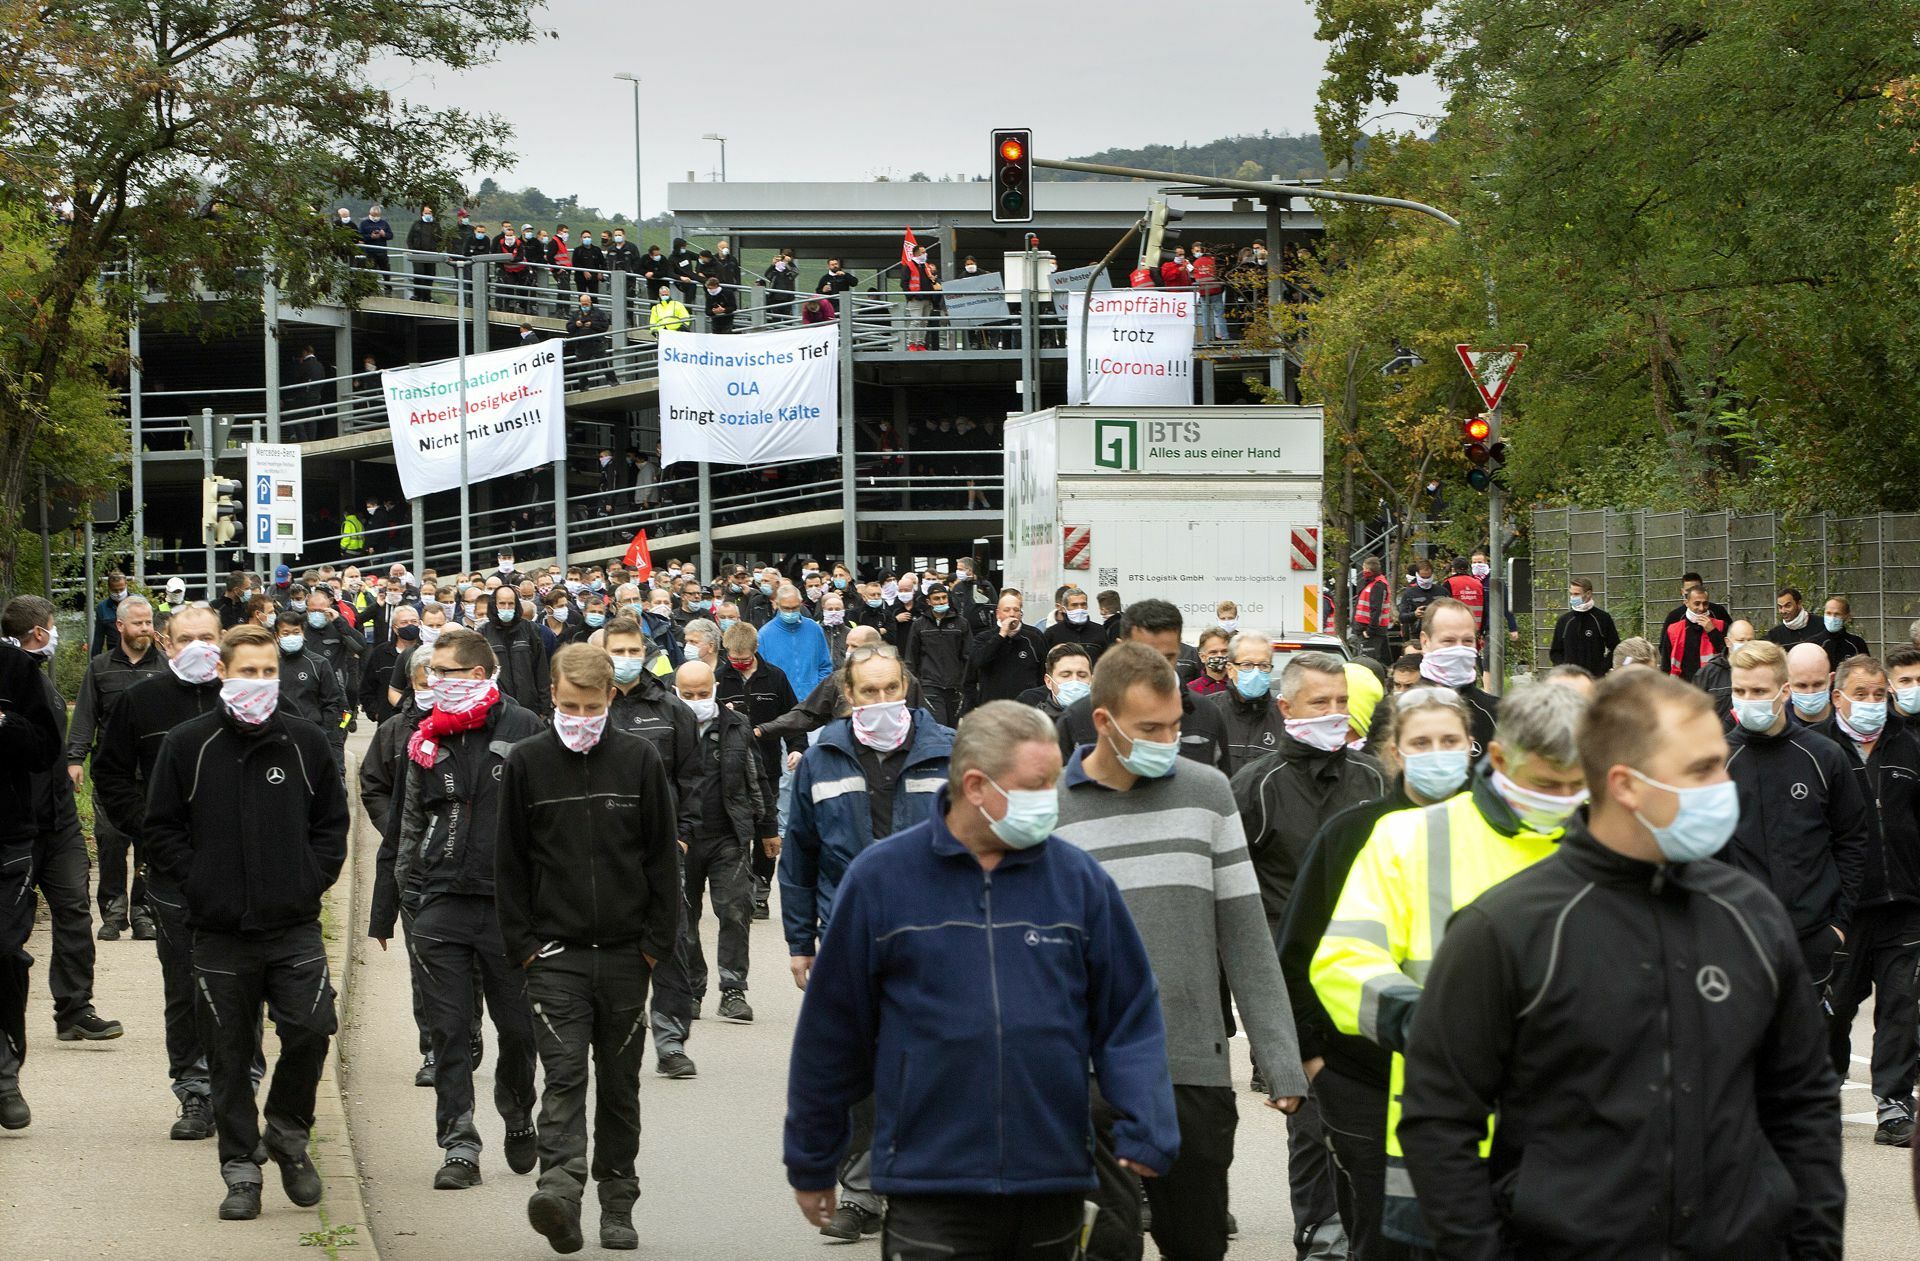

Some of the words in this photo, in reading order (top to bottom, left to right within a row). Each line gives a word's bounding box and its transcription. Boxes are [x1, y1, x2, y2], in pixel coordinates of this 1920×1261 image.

[1112, 327, 1155, 344] trotz
[663, 347, 793, 367] Skandinavisches
[799, 341, 829, 361] Tief
[389, 368, 510, 400] Transformation
[513, 362, 527, 376] in
[532, 351, 555, 369] die
[727, 381, 760, 396] OLA
[670, 405, 715, 425] bringt
[719, 409, 773, 426] soziale
[778, 404, 820, 422] Kälte
[419, 433, 459, 451] Nicht
[466, 424, 490, 440] mit
[494, 409, 541, 434] uns!!!
[1148, 421, 1201, 443] BTS
[1149, 447, 1181, 459] Alles
[1184, 449, 1207, 459] aus
[1210, 447, 1243, 459] einer
[1247, 447, 1281, 459] Hand
[1128, 574, 1145, 582] BTS
[1146, 574, 1178, 583] Logistik
[1180, 574, 1205, 582] GmbH
[1214, 574, 1287, 583] www.bts-logistik.de
